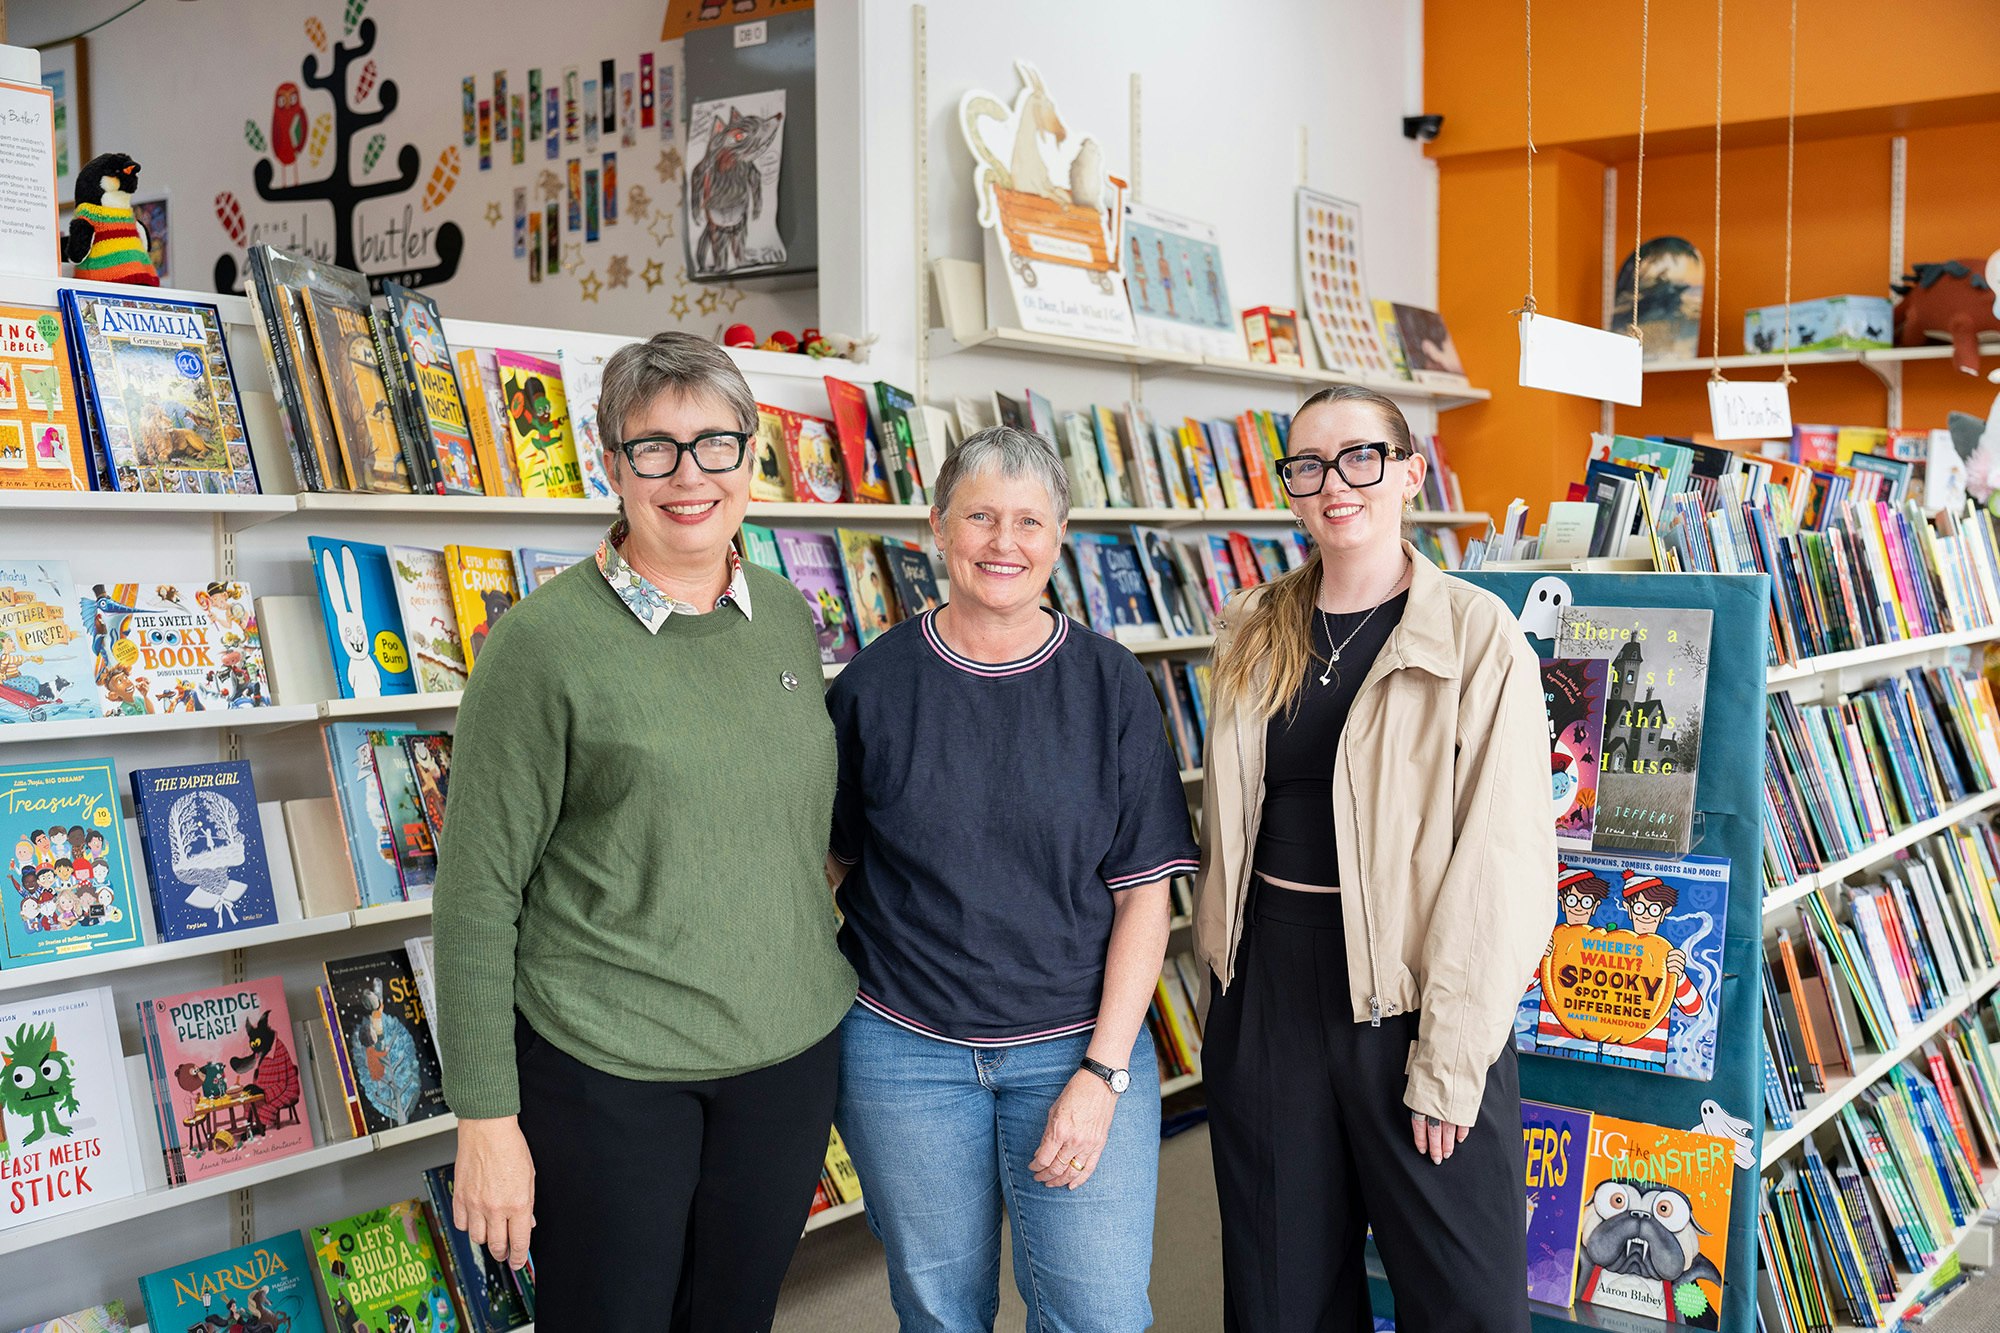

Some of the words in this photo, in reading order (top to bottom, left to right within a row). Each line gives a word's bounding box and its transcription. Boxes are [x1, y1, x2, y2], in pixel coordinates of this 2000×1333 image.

[8, 109, 40, 125] Butler?
[101, 307, 205, 340] ANIMALIA
[123, 336, 162, 346] Graeme
[163, 339, 179, 347] Base
[180, 358, 201, 372] 40
[418, 368, 447, 395] WHAT
[465, 556, 485, 568] EVEN
[462, 570, 510, 592] CRANKY
[0, 606, 45, 628] MOTHER
[134, 616, 157, 627] THE
[159, 615, 193, 627] SWEET
[196, 615, 207, 626] AS
[24, 625, 64, 646] PIRATE
[1571, 622, 1647, 642] There's
[1667, 629, 1678, 643] a
[381, 639, 399, 651] Poo
[140, 647, 215, 670] BOOK
[382, 652, 404, 664] Bum
[1625, 709, 1676, 728] this
[154, 778, 177, 791] THE
[179, 774, 213, 788] PAPER
[215, 772, 240, 786] GIRL
[0, 788, 103, 820] Treasury
[1615, 806, 1675, 825] JEFFERS
[1563, 855, 1581, 864] FIND:
[1582, 857, 1619, 868] PUMPKINS,
[1620, 859, 1653, 870] ZOMBIES,
[1654, 863, 1681, 873] GHOSTS
[1682, 865, 1697, 875] AND
[1699, 867, 1721, 877] MORE!
[1581, 937, 1644, 956] WHERE'S
[1580, 951, 1643, 972] WALLY?
[1558, 964, 1663, 1002] SPOOKY
[1575, 986, 1607, 1000] SPOT
[1615, 991, 1641, 1006] THE
[169, 992, 260, 1026] PORRIDGE
[1563, 998, 1651, 1019] DIFFERENCE
[178, 1018, 238, 1042] PLEASE!
[1567, 1012, 1598, 1023] MARTIN
[1600, 1016, 1647, 1030] HANDFORD
[1, 1152, 41, 1180] EAST
[50, 1138, 101, 1168] MEETS
[1628, 1139, 1650, 1160] the
[200, 1162, 219, 1171] Laura
[1611, 1142, 1727, 1188] MONSTER
[10, 1166, 93, 1215] STICK
[355, 1225, 395, 1253] LET'S
[351, 1246, 398, 1279] BUILD
[400, 1240, 412, 1262] A
[172, 1249, 290, 1308] NARNIA
[347, 1260, 428, 1306] BACKYARD
[1597, 1281, 1628, 1299] Aaron
[1629, 1289, 1664, 1308] Blabey
